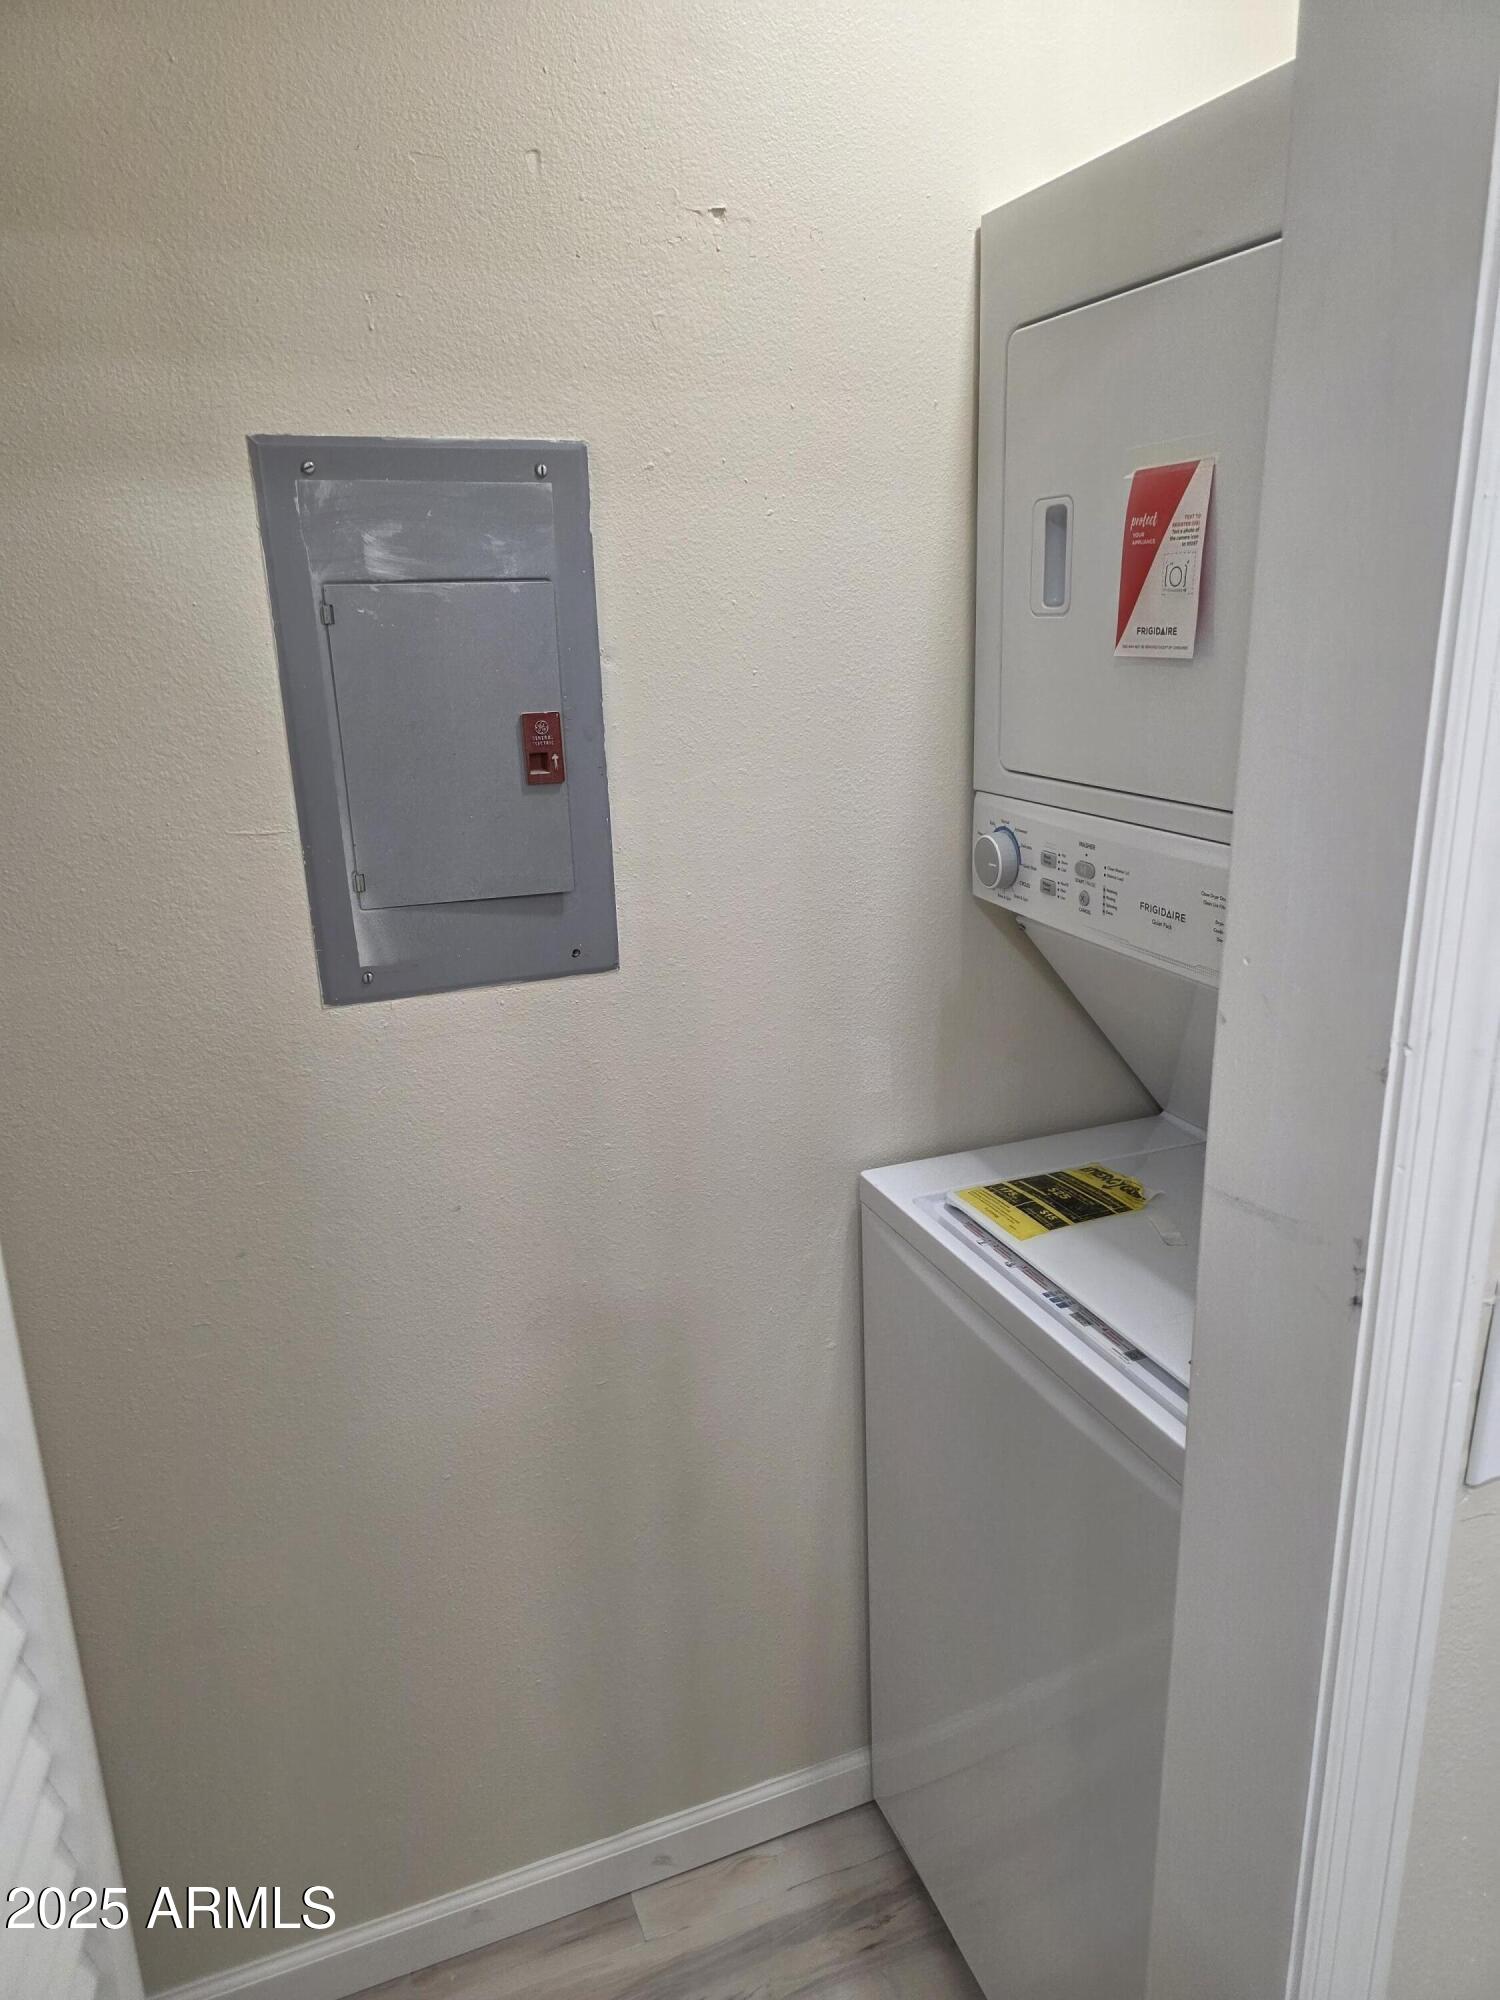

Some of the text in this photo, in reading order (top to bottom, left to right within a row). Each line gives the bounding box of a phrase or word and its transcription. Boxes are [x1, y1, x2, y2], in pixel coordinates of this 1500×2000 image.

[1130, 512, 1158, 531] protect
[1132, 538, 1156, 546] APPLIANCE
[1136, 626, 1178, 636] FRIGIDAIRE
[1139, 901, 1187, 923] FRIGIDAIRE
